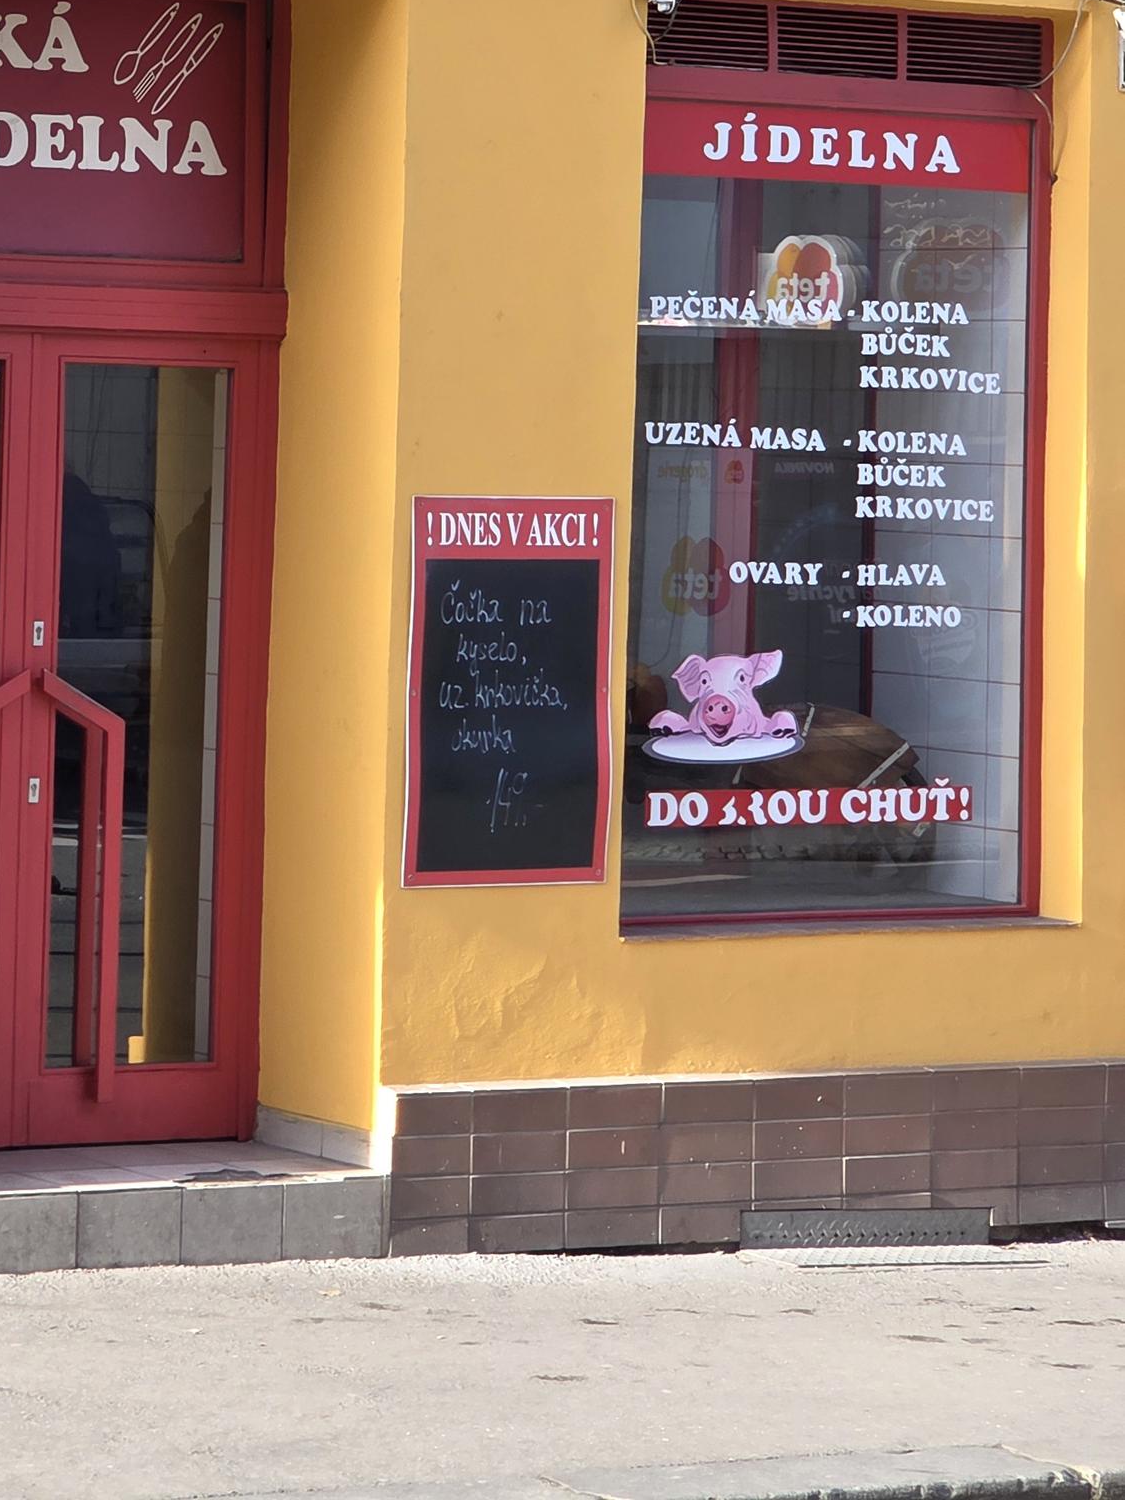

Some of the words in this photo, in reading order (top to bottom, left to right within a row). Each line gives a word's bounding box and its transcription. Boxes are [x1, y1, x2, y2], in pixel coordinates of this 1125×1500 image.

[703, 112, 960, 174] JÍDELNA
[649, 290, 759, 321] PEČENÁ
[766, 299, 842, 323] MASA
[861, 300, 969, 326] KOLENA
[861, 326, 950, 358] BŮČEK
[859, 366, 1001, 396] KRKOVICE
[645, 418, 741, 448] UZENÁ
[750, 427, 826, 452] MASA
[857, 430, 967, 456] KOLENA
[856, 457, 945, 487] BŮČEK
[854, 495, 995, 523] KRKOVICE
[440, 512, 501, 546] DNES
[507, 514, 523, 546] V
[526, 514, 586, 547] AKCI
[729, 561, 823, 585] OVARY
[856, 563, 945, 587] HLAVA
[441, 580, 504, 625] Čočka
[520, 599, 552, 626] na
[856, 605, 962, 628] KOLENO
[840, 777, 970, 824] CHUŤ!
